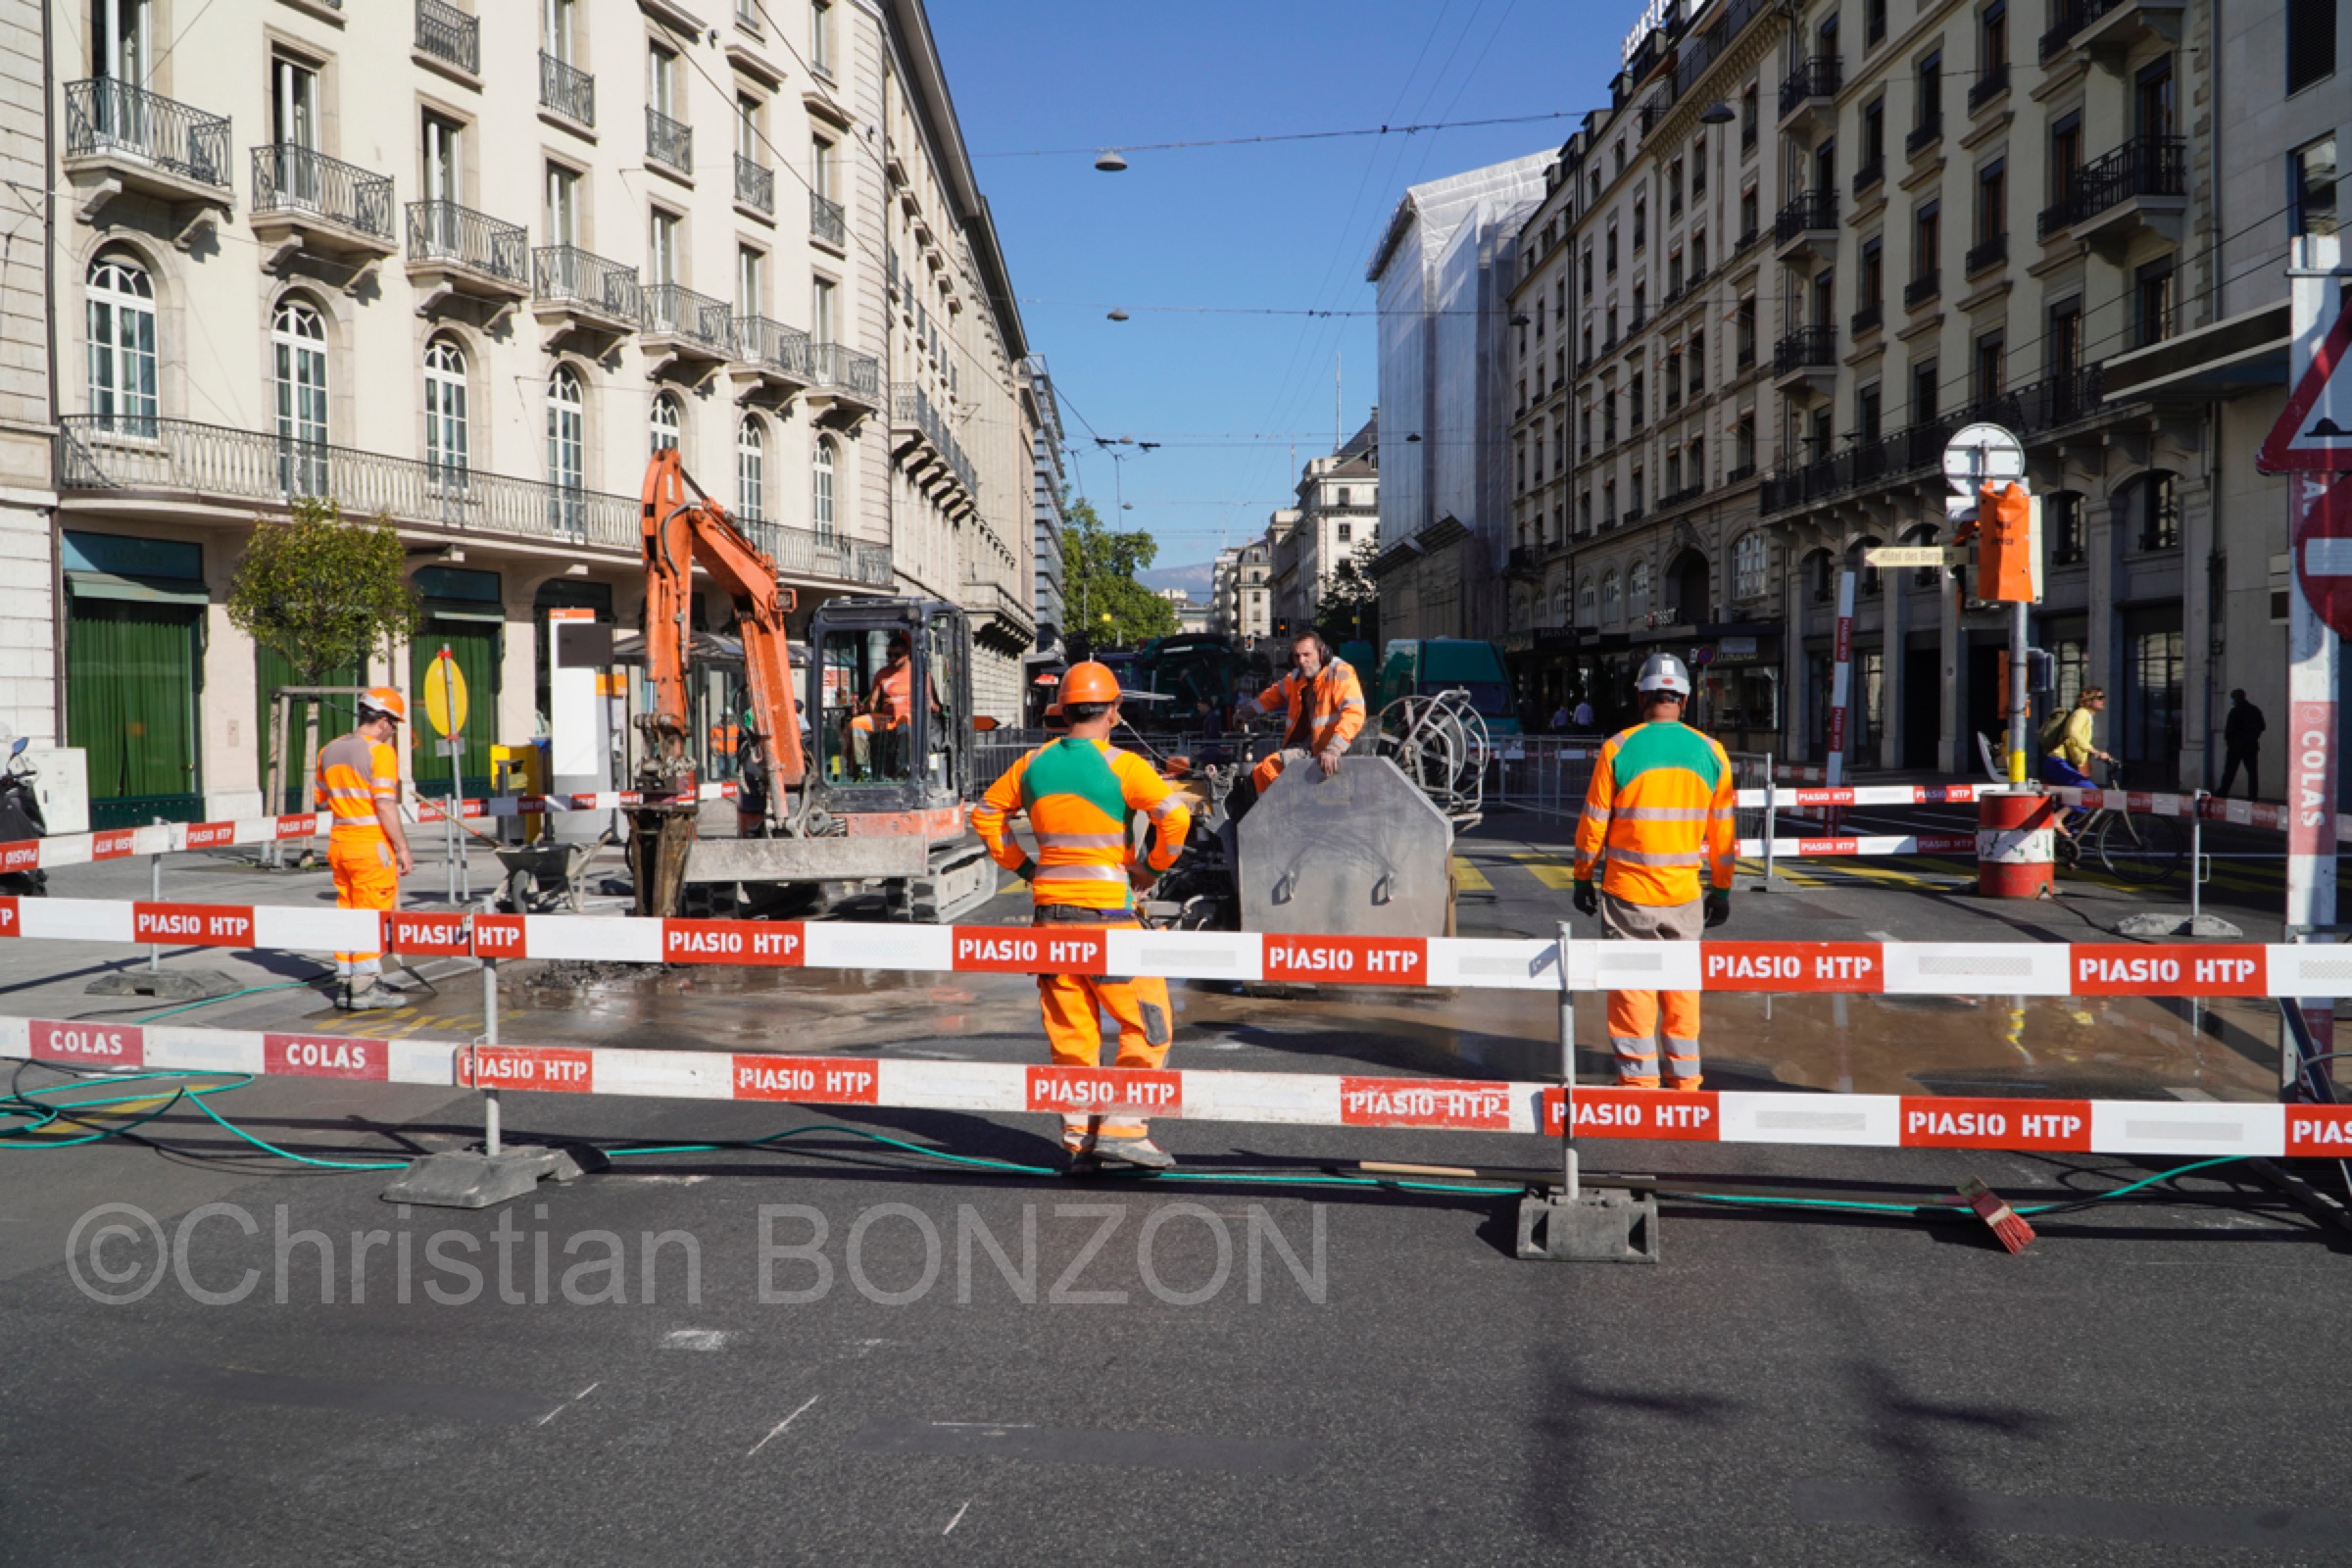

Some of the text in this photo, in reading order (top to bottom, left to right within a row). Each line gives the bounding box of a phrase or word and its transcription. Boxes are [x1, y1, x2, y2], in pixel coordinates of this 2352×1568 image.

[2300, 730, 2328, 828] COLAS
[1798, 792, 1853, 801] PIASIO HTP
[1950, 789, 1971, 799] HTP
[188, 827, 232, 844] PIASIO HTP
[1800, 841, 1855, 851] PIASIO HTP
[138, 913, 250, 936] PIASIO HTP
[477, 926, 520, 946] HTP
[669, 932, 799, 955] PIASIO HTP
[959, 938, 1099, 963] PIASIO HTP
[1269, 947, 1418, 973] PIASIO HTP
[1708, 956, 1873, 979] PIASIO HTP
[2079, 957, 2256, 983] PIASIO HTP
[50, 1030, 122, 1055] COLAS
[285, 1043, 366, 1069] COLAS
[543, 1059, 587, 1081] HTP
[739, 1067, 871, 1093] PIASIO HTP
[1034, 1079, 1175, 1104] PIASIO HTP
[1349, 1091, 1500, 1118] PIASIO HTP
[1551, 1102, 1710, 1128] PIASIO HTP
[1908, 1110, 2082, 1138] PIASIO HTP
